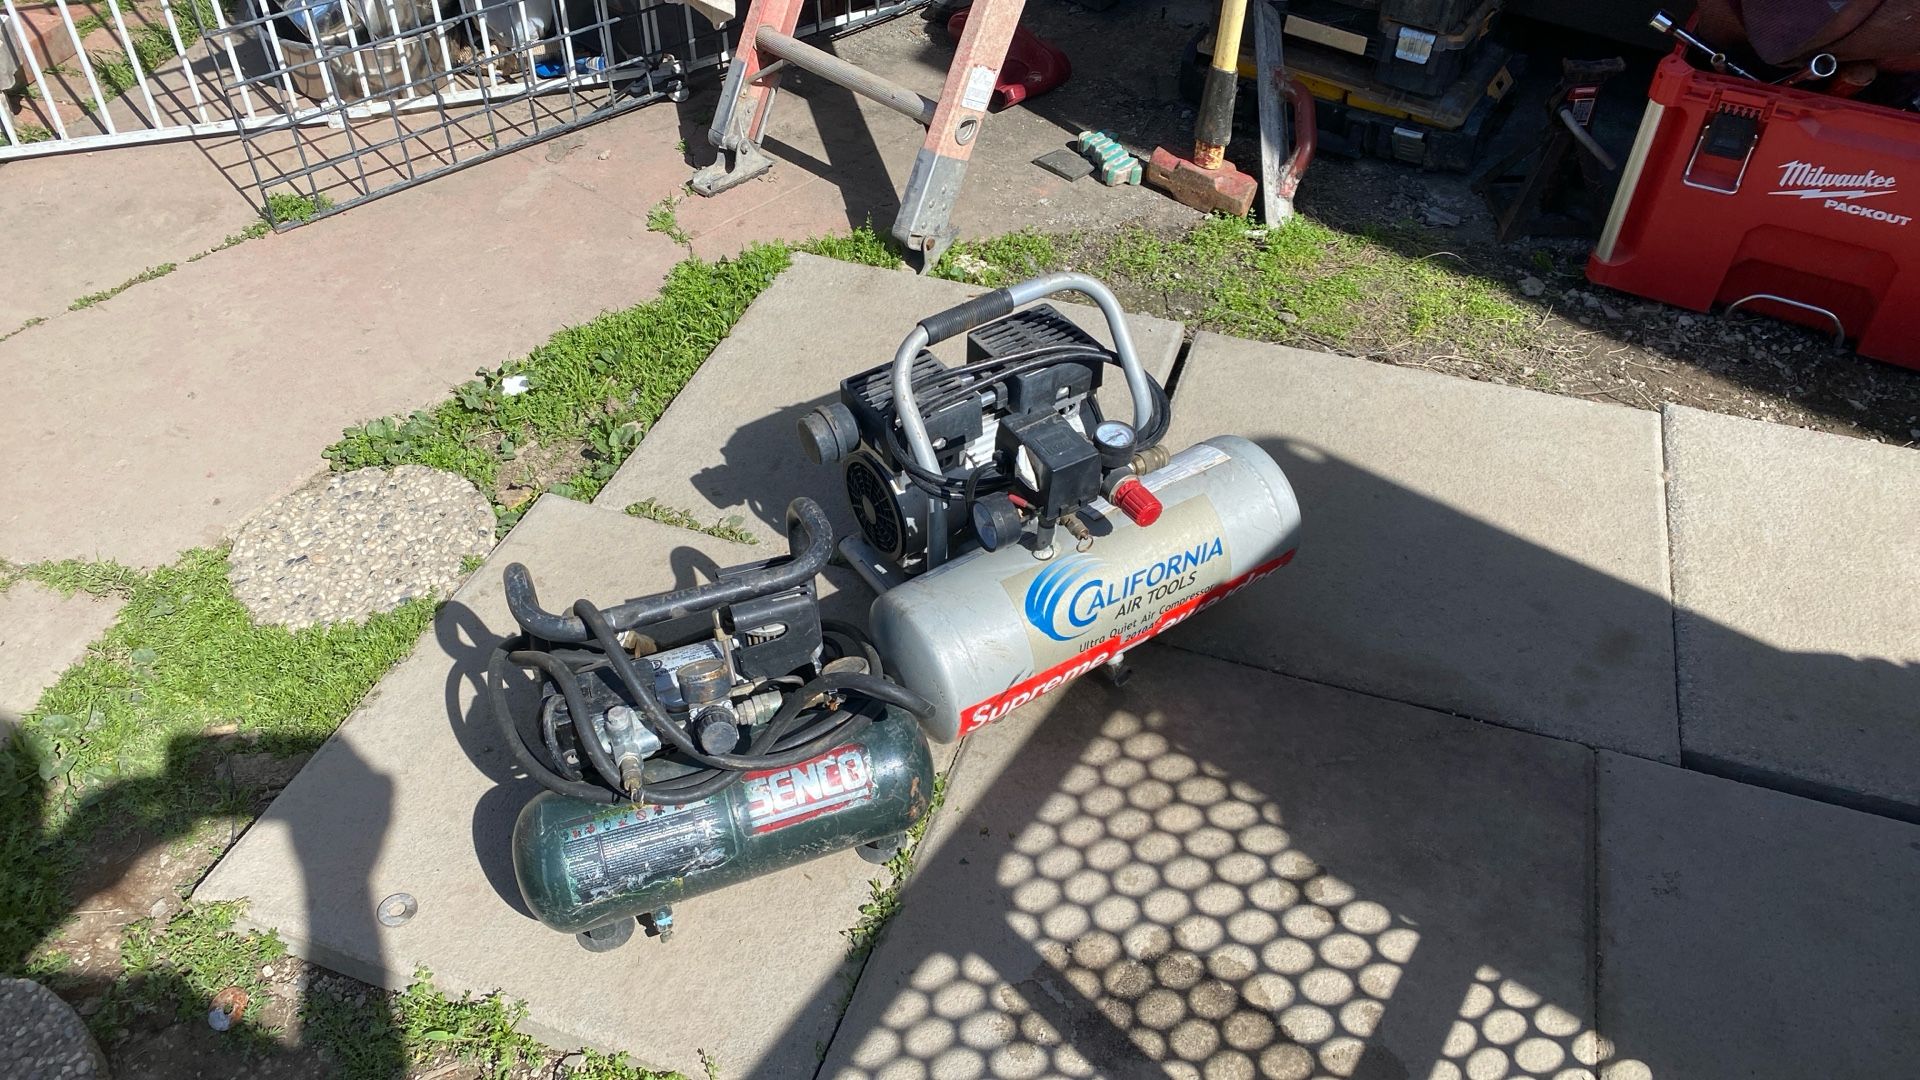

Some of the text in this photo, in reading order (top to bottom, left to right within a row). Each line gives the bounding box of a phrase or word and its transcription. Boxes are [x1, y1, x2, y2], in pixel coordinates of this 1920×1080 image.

[1777, 160, 1897, 188] Milwaukee
[1823, 199, 1912, 225] PACKOUT
[1068, 537, 1223, 628] CALIFORNIA
[1114, 596, 1141, 620] AIR
[1147, 570, 1197, 604] TOOLS
[1079, 583, 1216, 653] Ultra Quiet Air Compressor
[966, 650, 1111, 733] Supreme
[748, 750, 867, 816] SENCO
